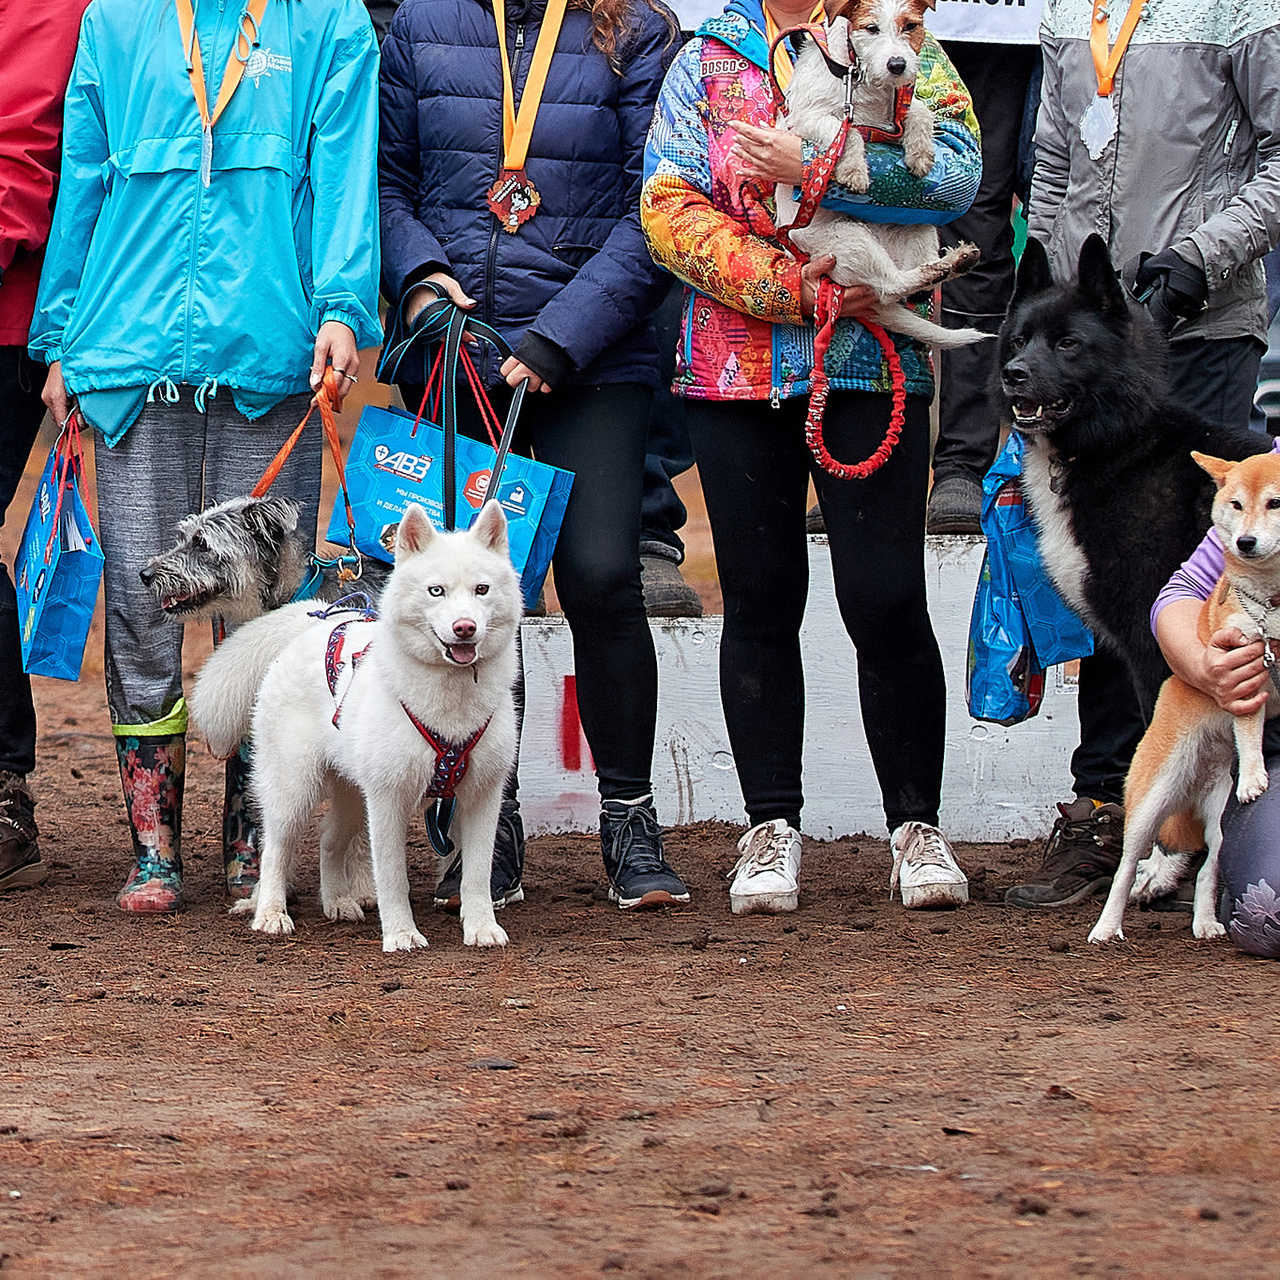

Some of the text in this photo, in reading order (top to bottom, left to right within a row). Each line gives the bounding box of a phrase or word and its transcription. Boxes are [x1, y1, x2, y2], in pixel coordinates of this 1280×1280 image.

[701, 60, 736, 76] BOSCO
[509, 214, 519, 226] 2
[396, 487, 443, 510] МЫ ПРОИЗВОД
